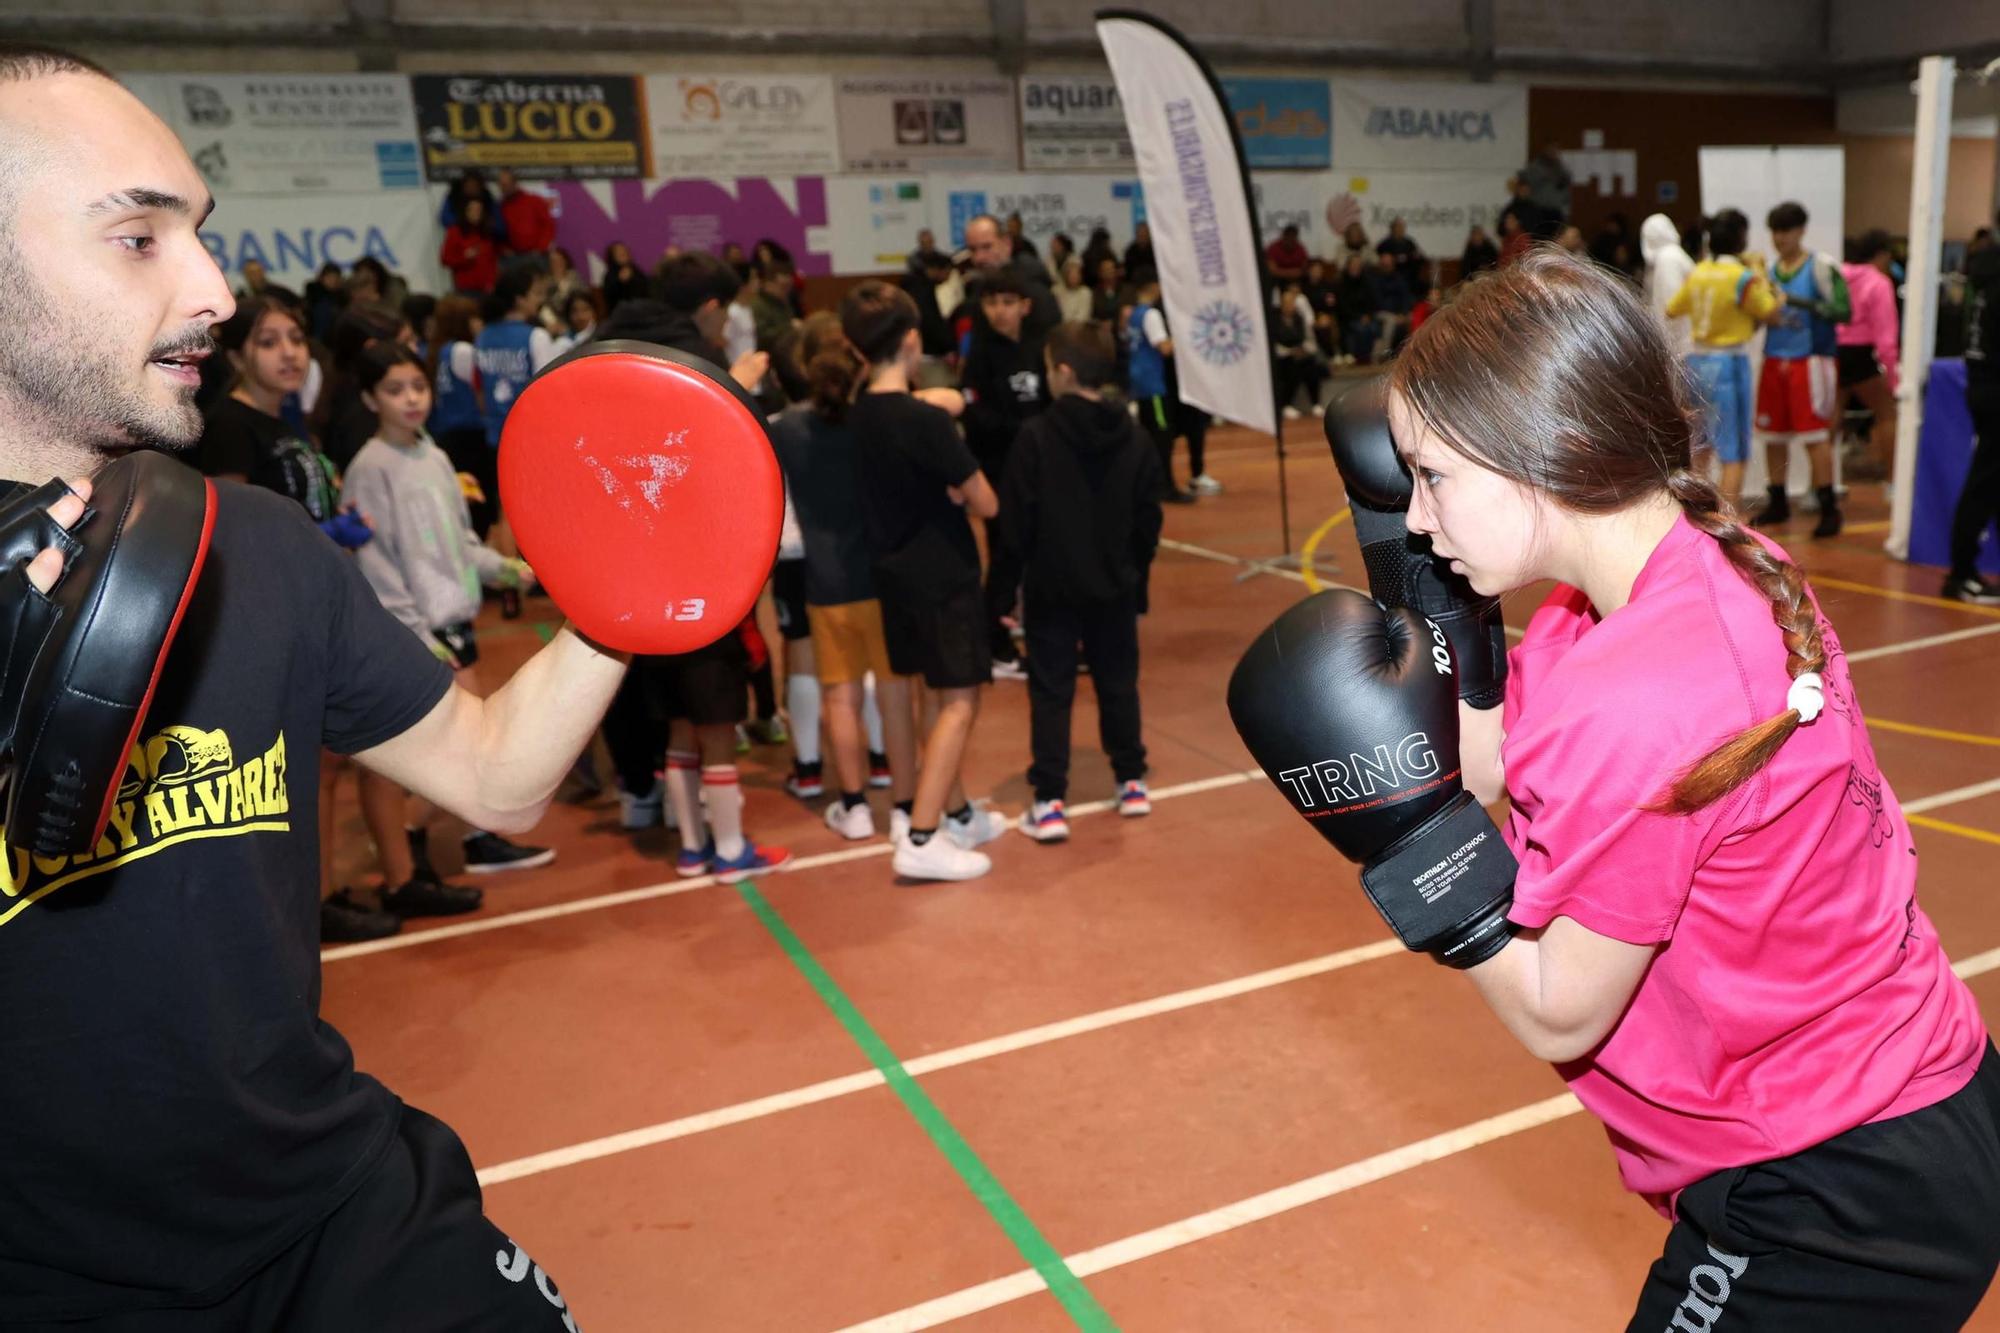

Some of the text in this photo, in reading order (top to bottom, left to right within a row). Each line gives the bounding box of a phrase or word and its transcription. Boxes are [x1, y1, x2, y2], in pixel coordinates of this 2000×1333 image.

[446, 79, 604, 103] Taberna
[446, 100, 617, 141] LUCIO
[1235, 99, 1329, 138] des
[1365, 105, 1497, 141] ABANCA
[197, 224, 399, 273] BANCA
[144, 729, 290, 838] ALVAREZ
[1279, 732, 1440, 807] TRNG
[1412, 859, 1449, 886] DECATHLON
[1451, 831, 1488, 861] OUTSHOCK
[1432, 864, 1458, 884] TRAINING
[1457, 851, 1478, 868] GLOVES
[1421, 865, 1470, 899] FIGHT YOUR LIMITS
